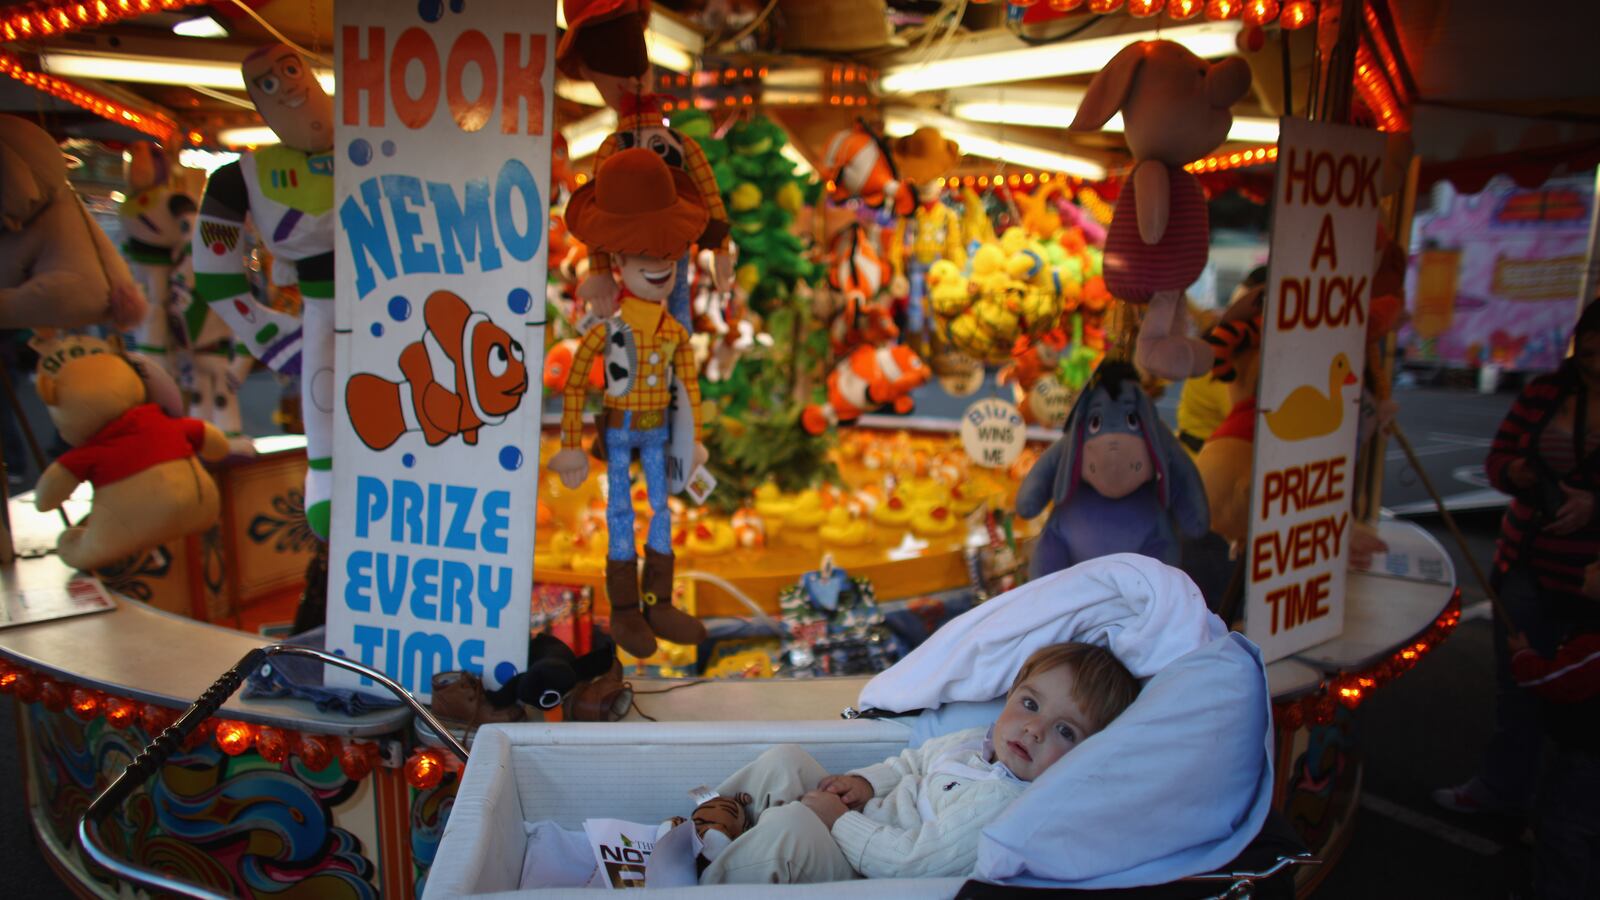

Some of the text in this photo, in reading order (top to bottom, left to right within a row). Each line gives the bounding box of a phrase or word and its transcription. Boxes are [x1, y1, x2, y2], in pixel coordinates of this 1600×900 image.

[342, 25, 547, 137] HOOK
[1285, 147, 1382, 208] HOOK
[339, 158, 543, 301] NEMO
[1310, 212, 1338, 272] A
[1277, 275, 1368, 332] DUCK
[968, 403, 1022, 427] Blue
[977, 426, 1015, 444] WINS
[983, 448, 1005, 464] ME
[1262, 455, 1348, 521] PRIZE
[355, 475, 511, 555] PRIZE
[1252, 511, 1349, 583] EVERY
[344, 550, 513, 629] EVERY
[1265, 571, 1333, 636] TIME
[353, 624, 486, 695] TIME
